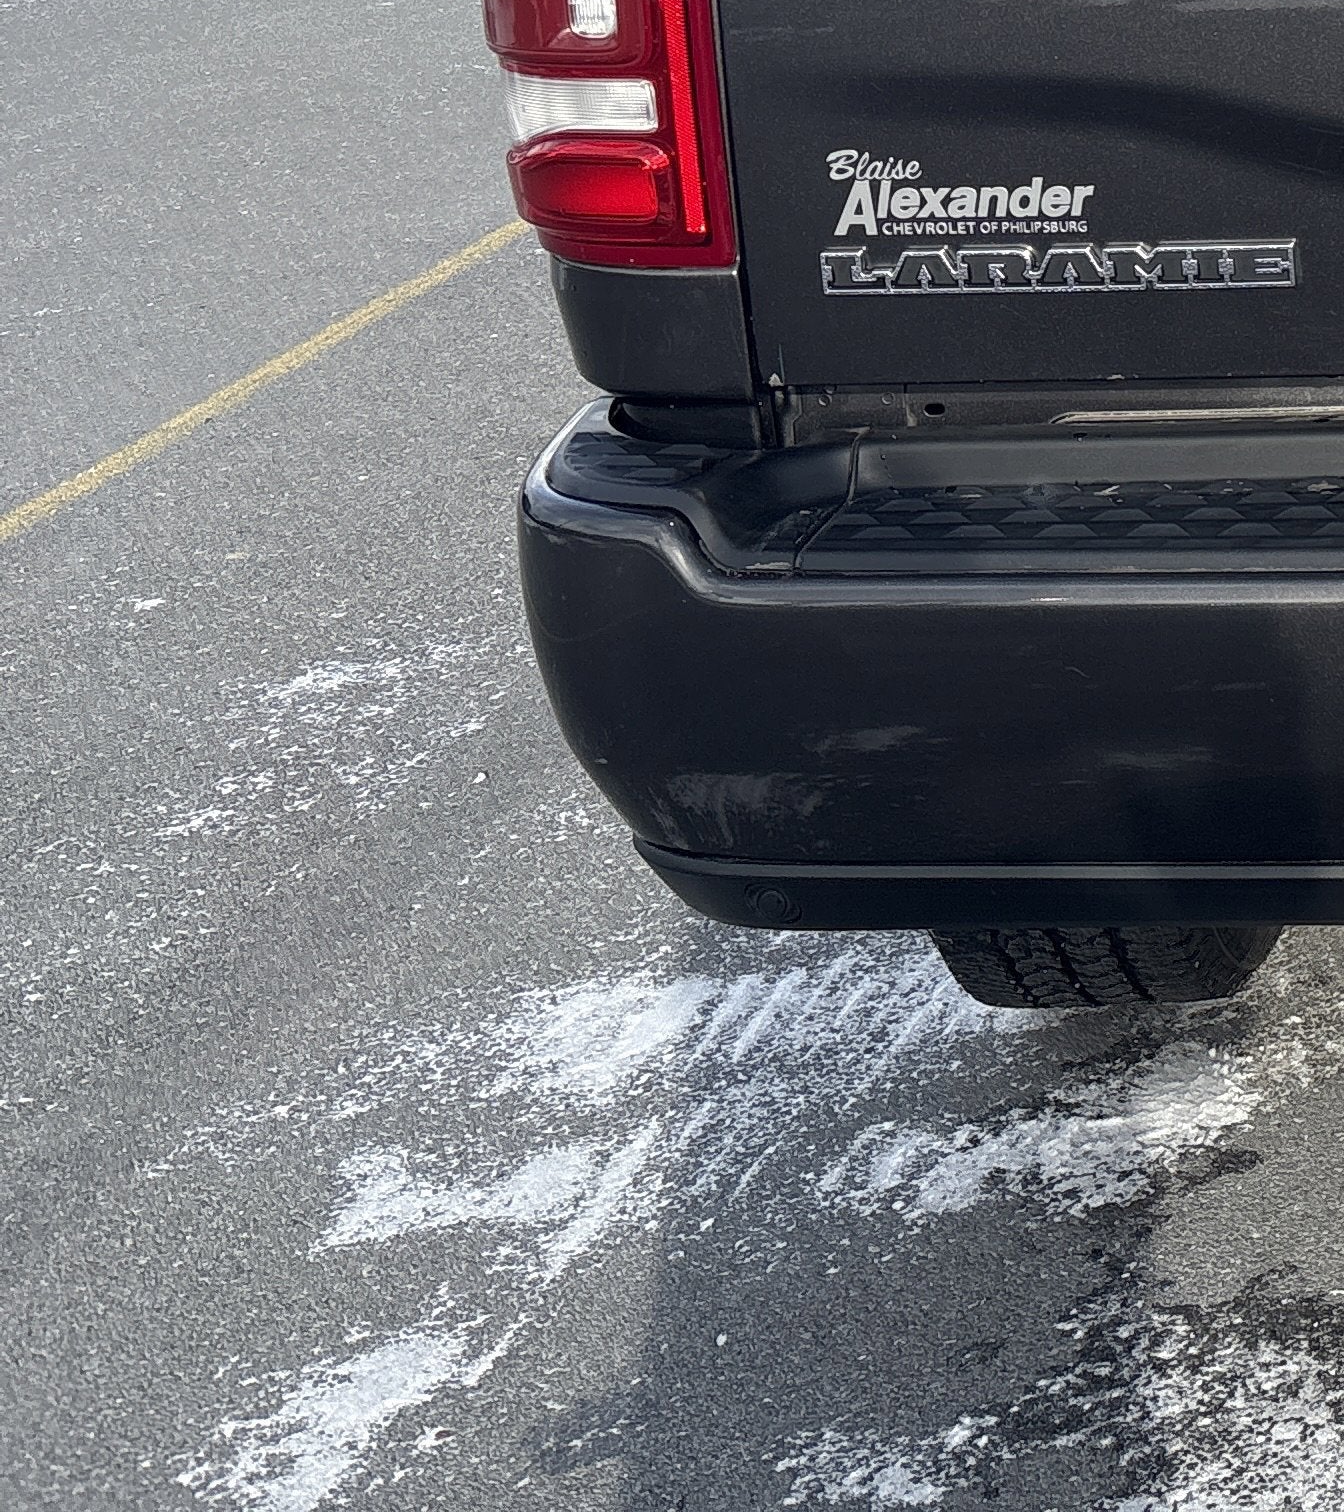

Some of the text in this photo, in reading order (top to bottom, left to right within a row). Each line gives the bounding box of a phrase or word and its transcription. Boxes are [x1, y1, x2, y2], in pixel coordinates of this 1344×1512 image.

[826, 149, 922, 181] Blaise
[834, 177, 1095, 236] Alexander
[882, 220, 1088, 235] CHEVROLET OF PHILIPSBURG
[820, 238, 1297, 295] LARAMIE
